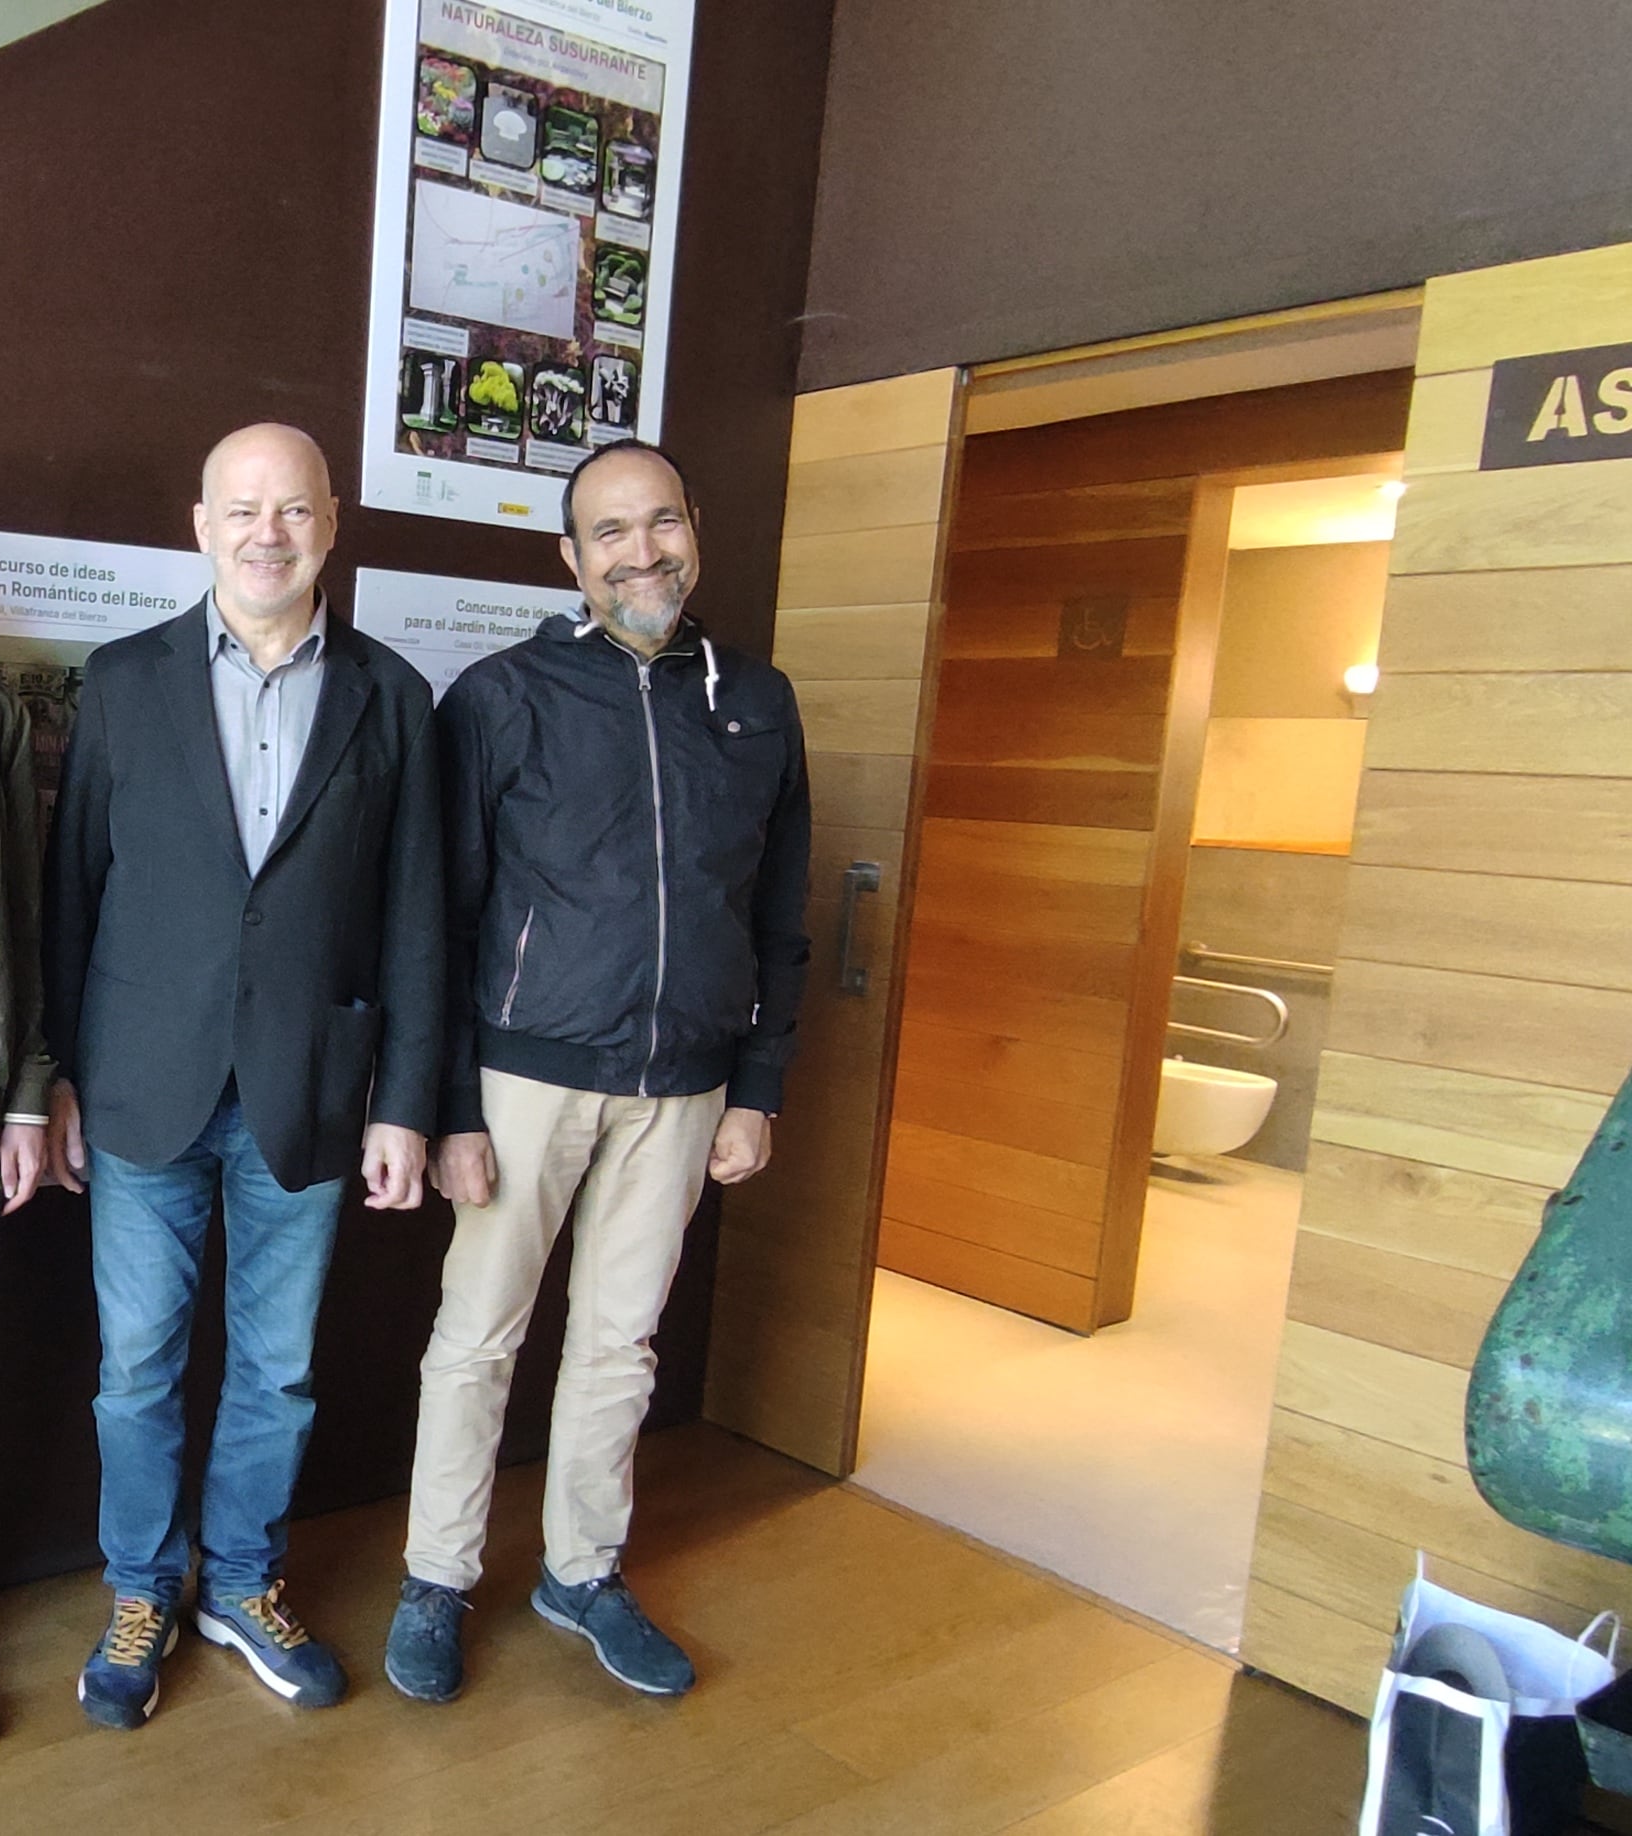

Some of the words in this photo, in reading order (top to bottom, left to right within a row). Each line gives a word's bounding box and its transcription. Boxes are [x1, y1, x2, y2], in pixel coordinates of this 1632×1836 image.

[441, 2, 545, 49] NATURALEZA
[548, 34, 647, 81] SUSURRANTE
[49, 562, 70, 578] de
[72, 562, 116, 582] ideas
[11, 580, 98, 604] Romántico
[101, 589, 125, 606] del
[128, 591, 177, 611] Bierzo
[62, 610, 77, 621] del
[78, 611, 108, 624] Bierzo
[455, 598, 514, 618] Concurso
[515, 605, 531, 619] de
[404, 616, 433, 631] para
[434, 616, 446, 631] el
